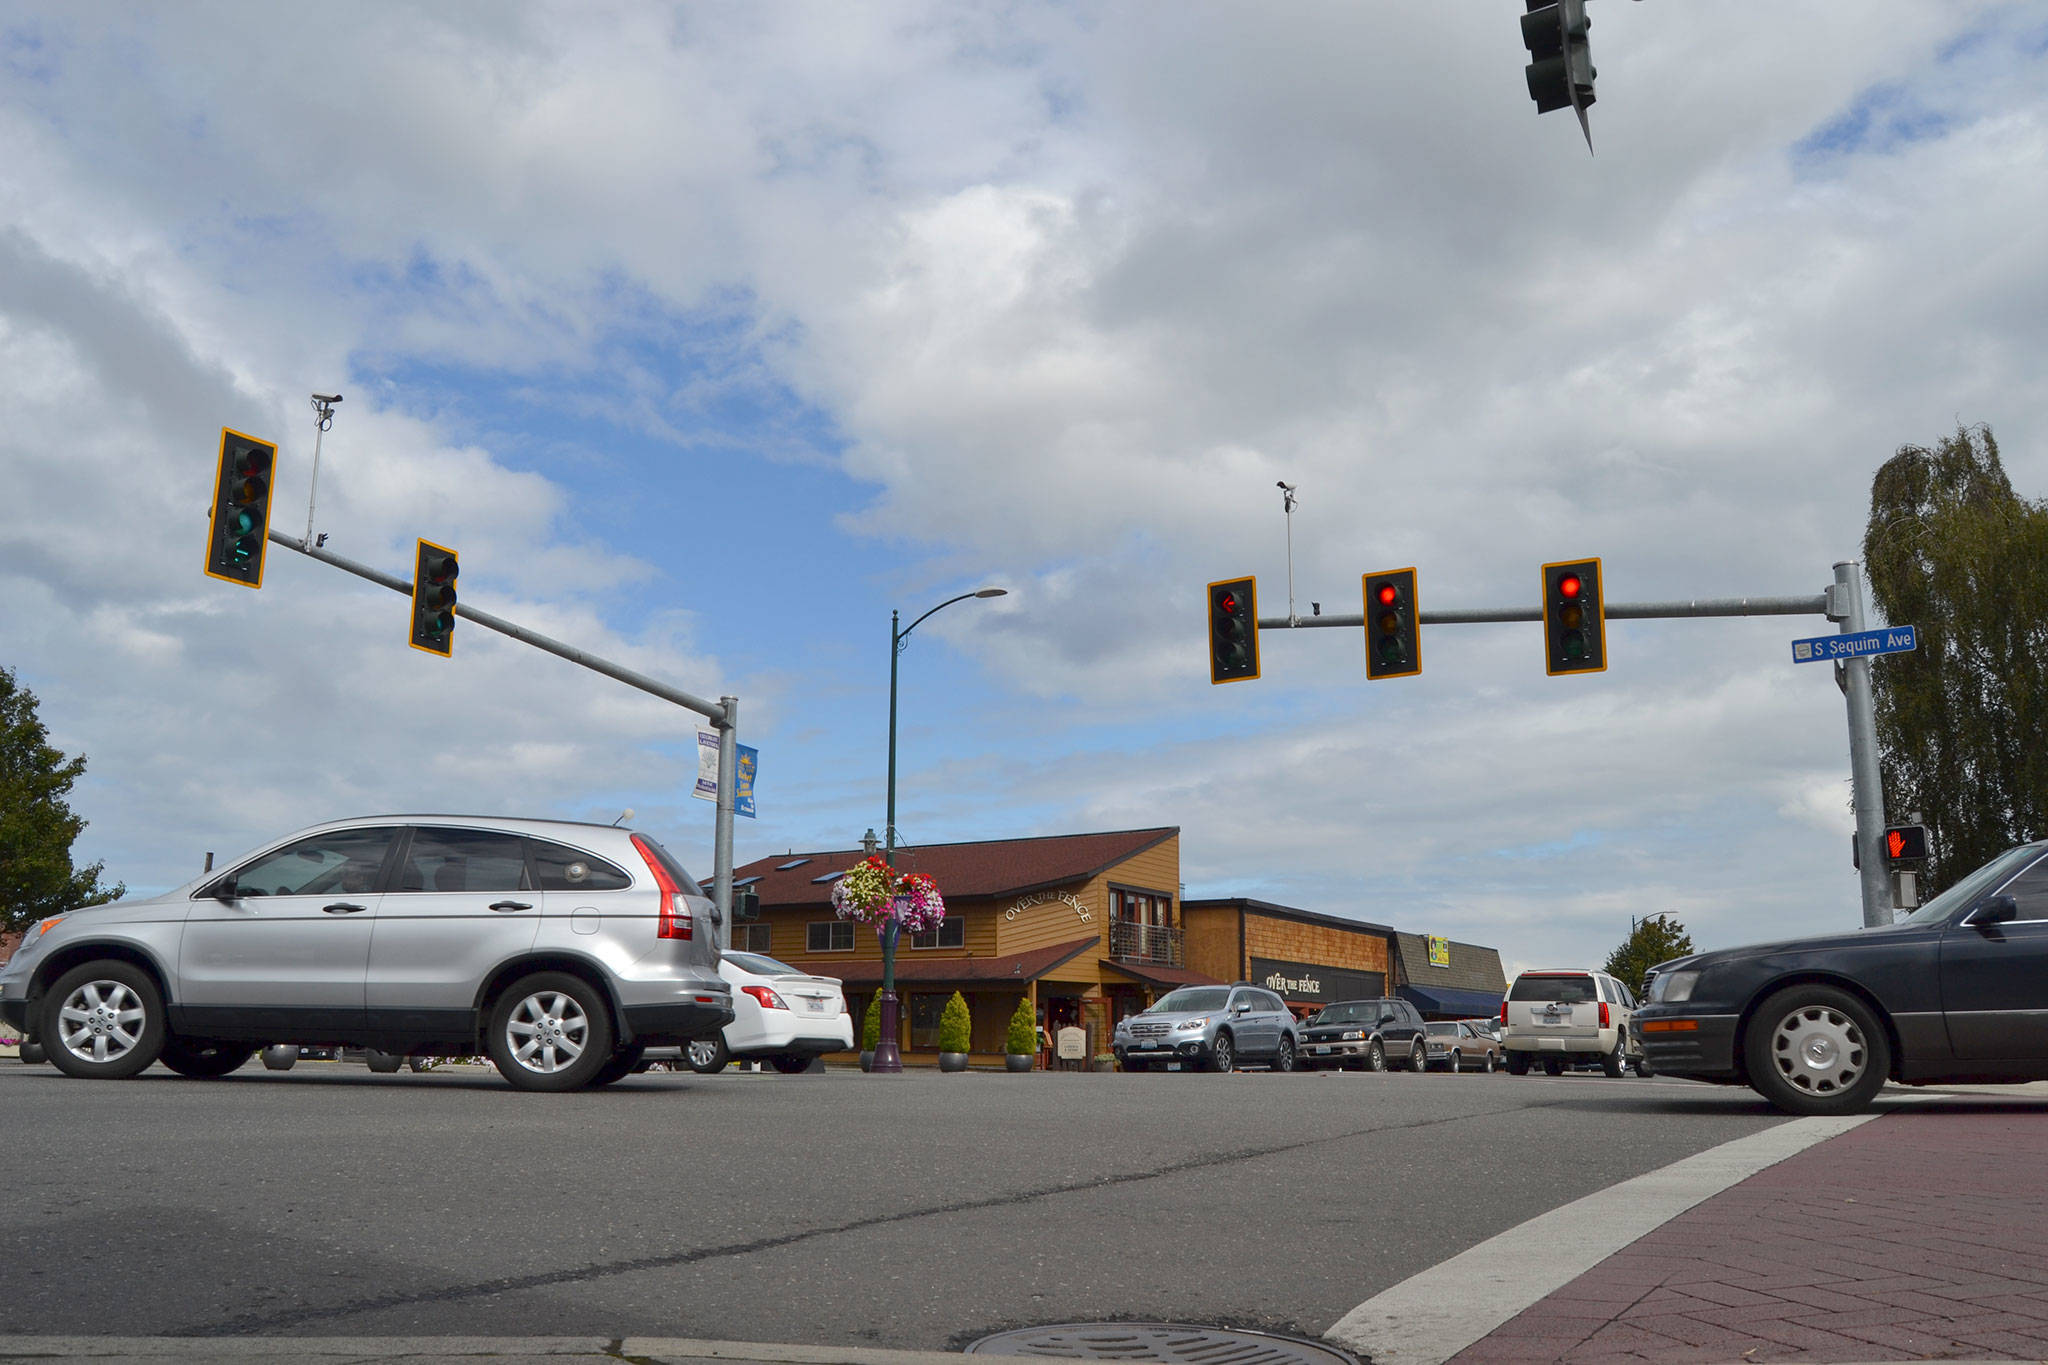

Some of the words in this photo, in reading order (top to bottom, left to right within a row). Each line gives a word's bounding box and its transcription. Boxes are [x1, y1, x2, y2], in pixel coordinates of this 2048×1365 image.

[1815, 642, 1824, 656] S
[1829, 637, 1881, 656] Sequim
[1887, 633, 1911, 648] Ave
[1005, 895, 1042, 921] OVER
[1058, 890, 1091, 924] FENCE
[1266, 972, 1289, 995] OVER
[1287, 979, 1298, 990] THE
[1299, 974, 1320, 993] FENCE
